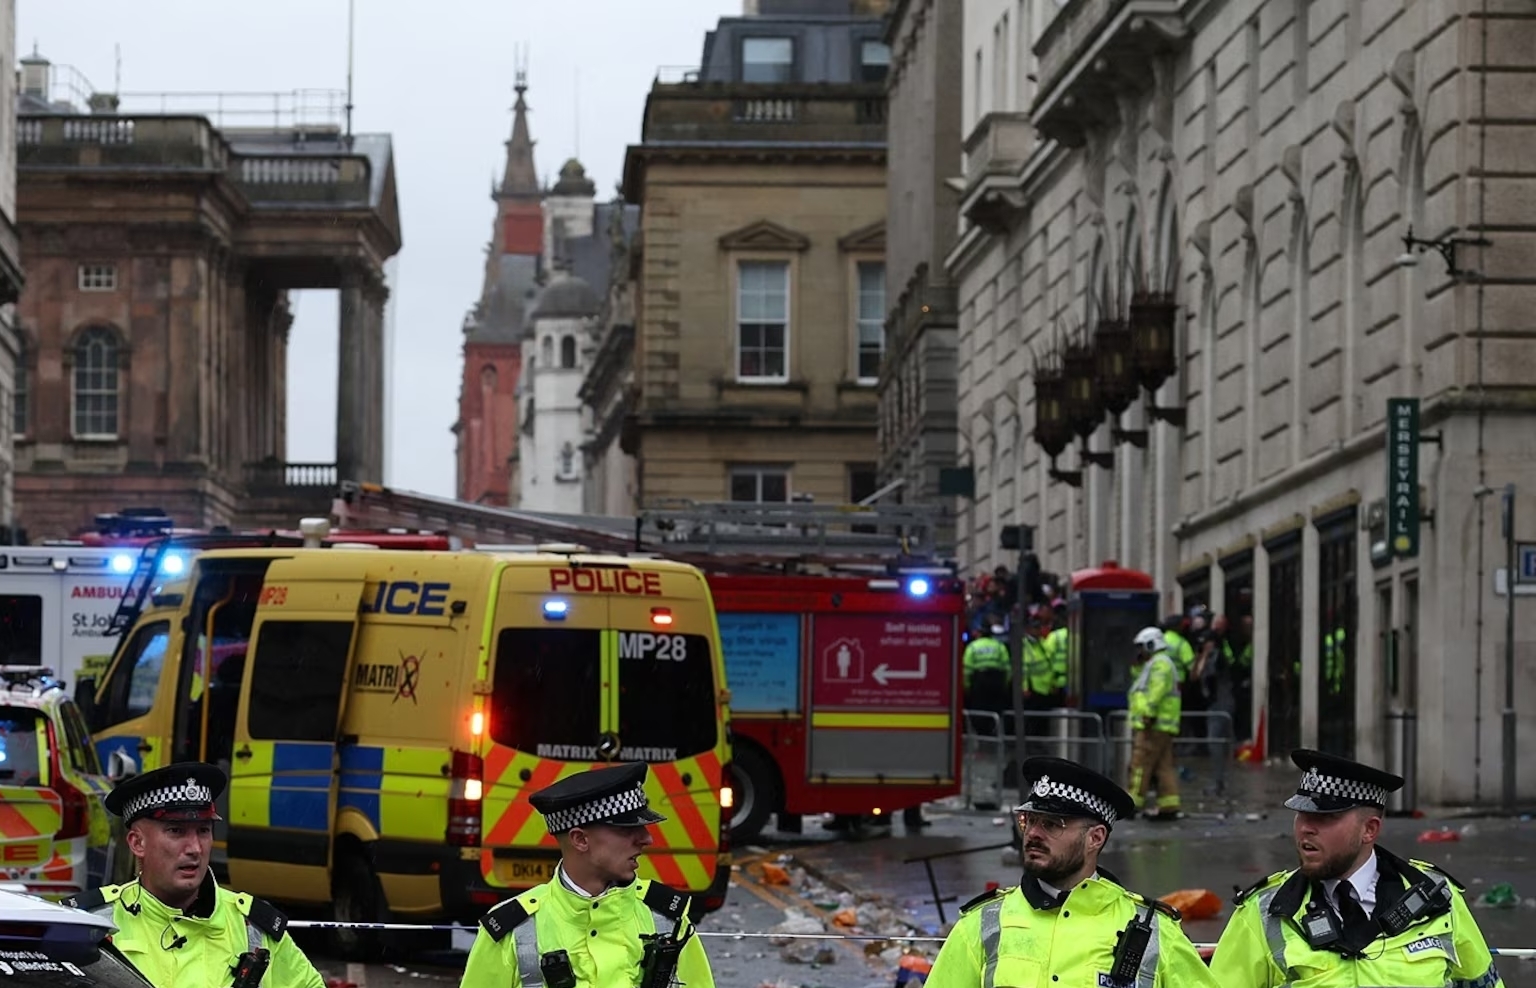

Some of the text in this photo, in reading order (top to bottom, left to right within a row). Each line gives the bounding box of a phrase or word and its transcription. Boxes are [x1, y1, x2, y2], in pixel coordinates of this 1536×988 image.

[1396, 404, 1412, 533] MERSEYRAIL
[549, 568, 663, 596] POLICE
[618, 631, 688, 662] MP28
[536, 743, 678, 761] MATRIX MATRIX
[513, 862, 543, 878] DK14
[1407, 937, 1442, 953] POLICE
